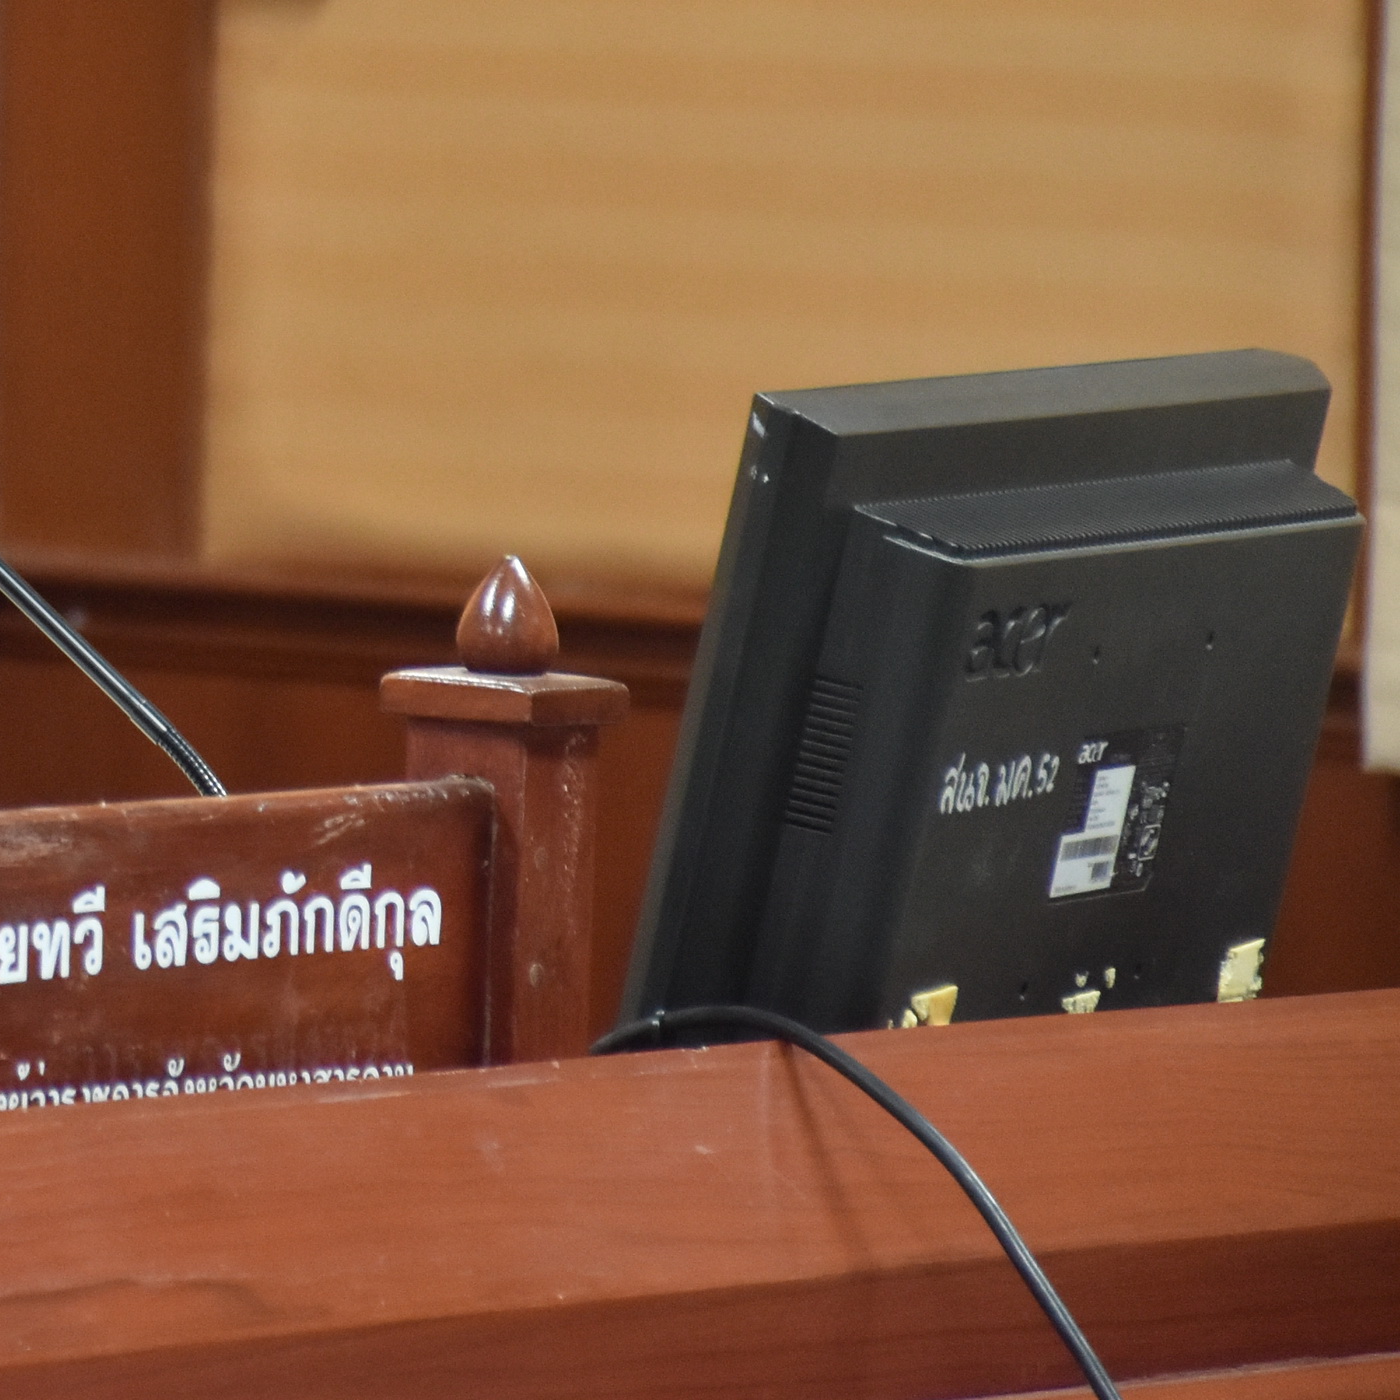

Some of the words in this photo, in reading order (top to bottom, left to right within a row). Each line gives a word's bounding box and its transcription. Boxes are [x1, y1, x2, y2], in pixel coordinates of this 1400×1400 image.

[964, 600, 1074, 683] acer
[131, 861, 443, 981] เสริมภักดีกุล
